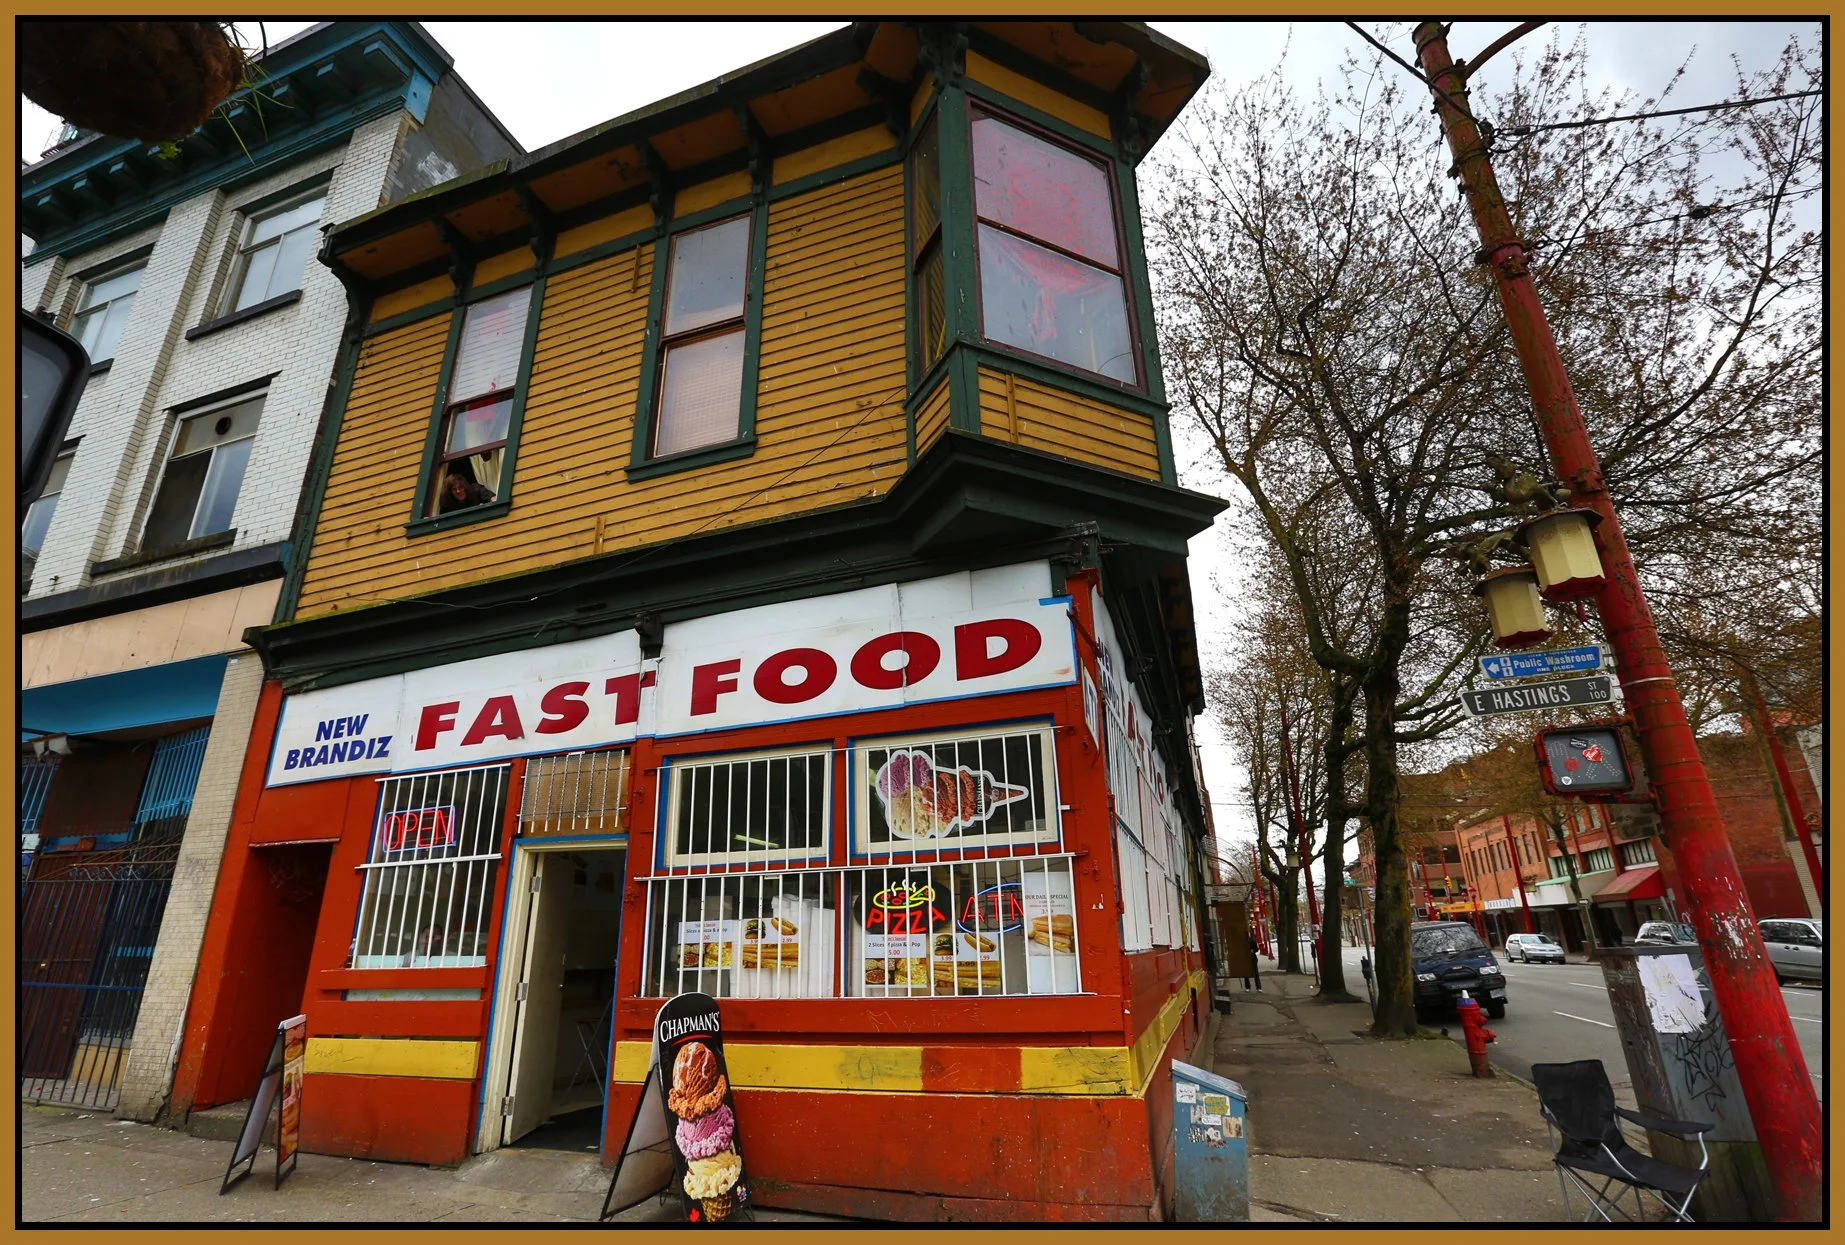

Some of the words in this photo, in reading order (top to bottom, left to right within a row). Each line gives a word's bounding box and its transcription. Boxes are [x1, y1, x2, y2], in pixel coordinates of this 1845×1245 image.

[1513, 658, 1542, 669] Public
[1545, 653, 1595, 666] Washroom
[415, 670, 656, 751] FAST
[690, 618, 1042, 716] FOOD
[1474, 695, 1485, 711] E
[1492, 685, 1571, 710] HASTINGS
[1588, 681, 1597, 690] ST
[1589, 690, 1607, 700] 100
[315, 714, 369, 742] NEW
[284, 736, 393, 770] BRANDIZ
[385, 810, 453, 850] OPEN
[867, 907, 946, 934] PIZZA
[660, 1012, 720, 1042] CHAPMAN'S
